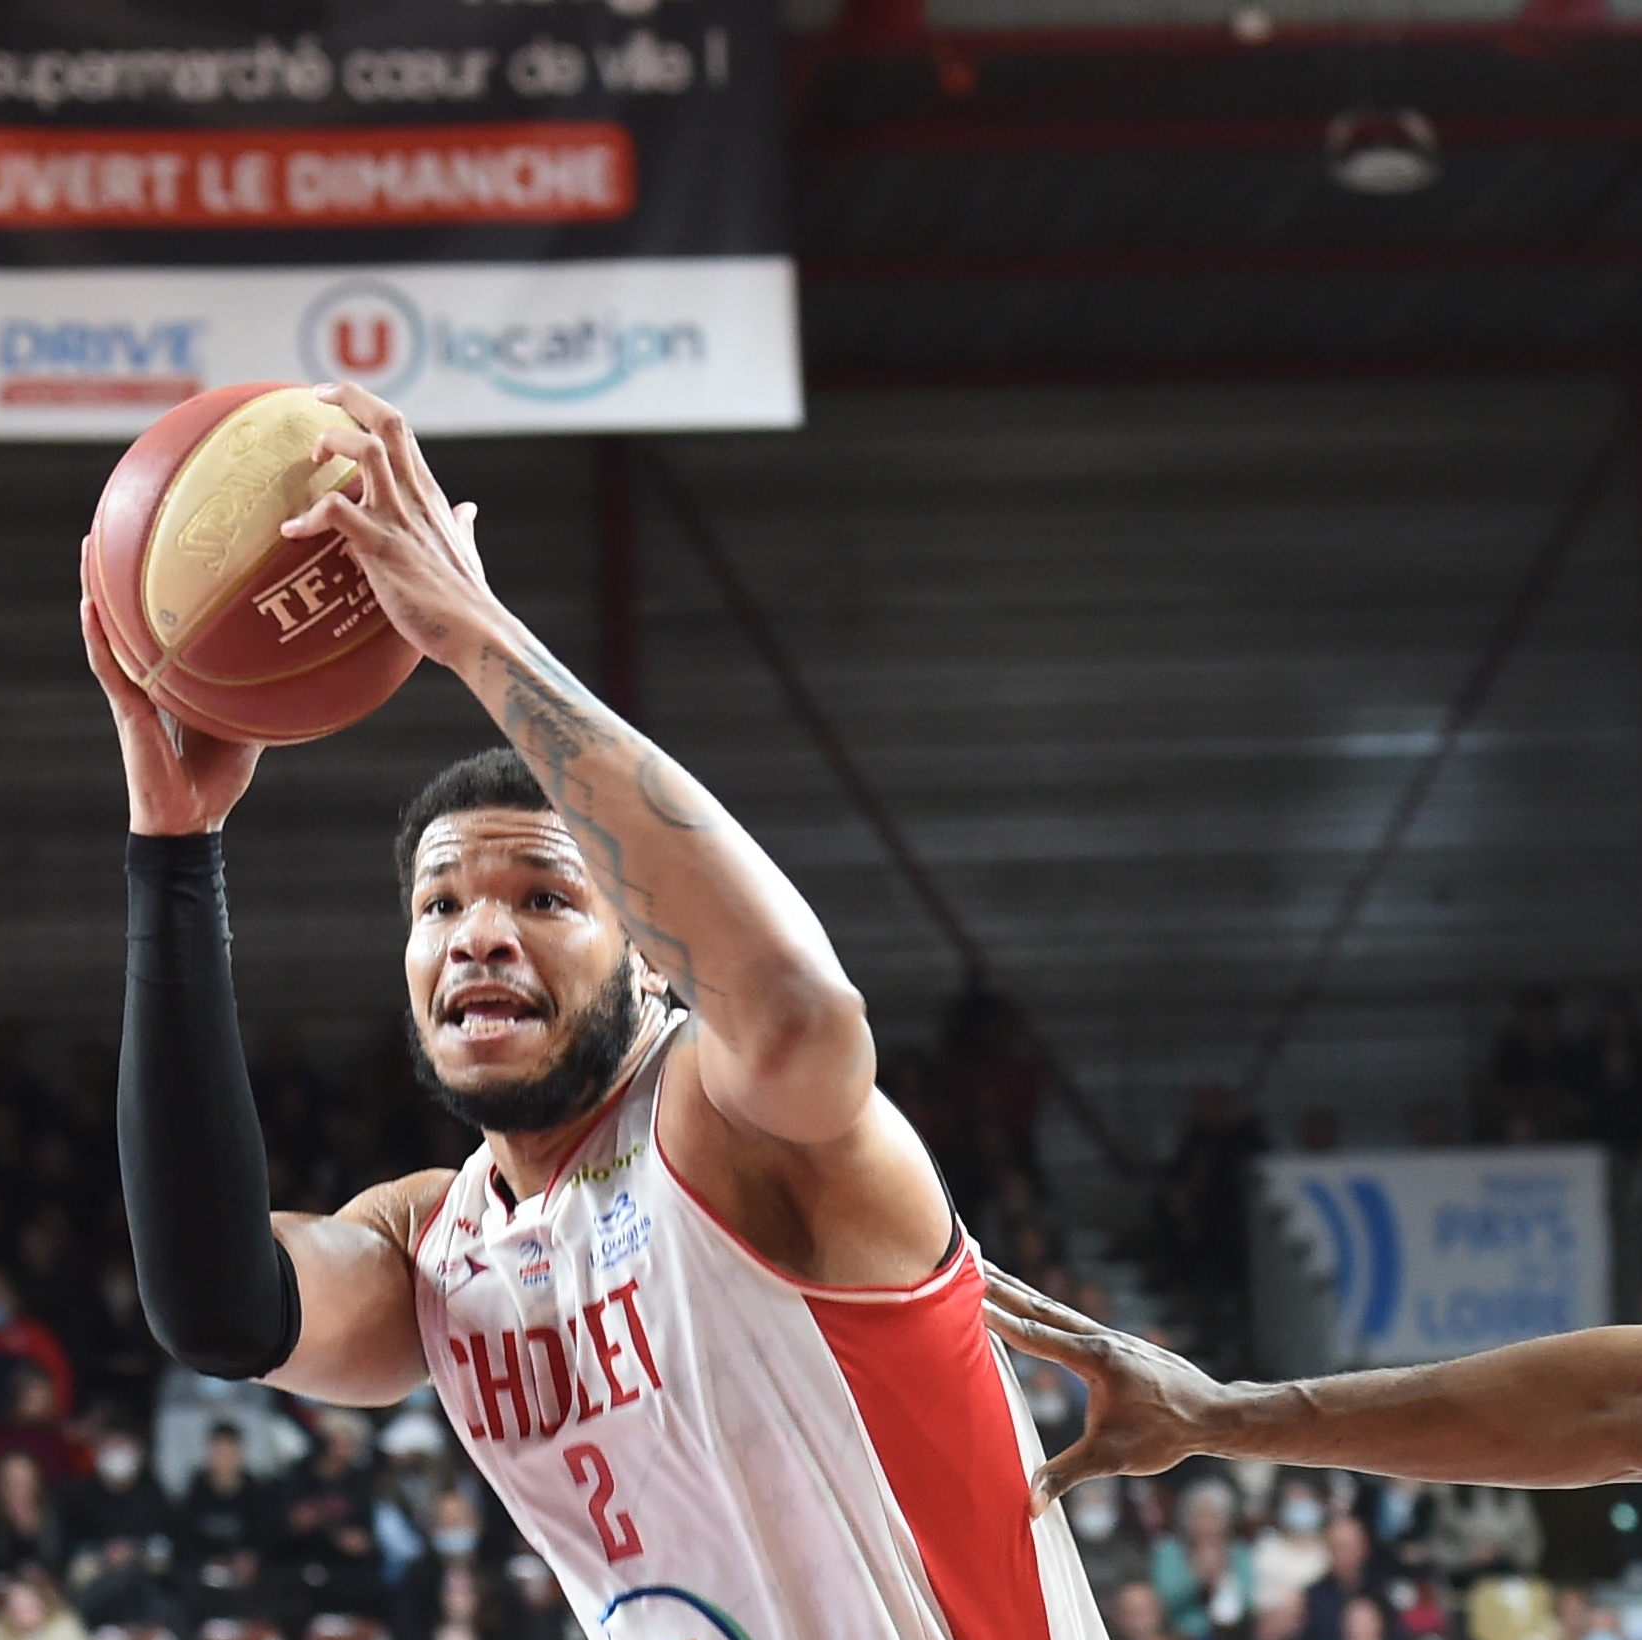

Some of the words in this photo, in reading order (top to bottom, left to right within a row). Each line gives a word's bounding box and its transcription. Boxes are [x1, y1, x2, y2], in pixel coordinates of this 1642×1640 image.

[198, 152, 269, 213] LE
[285, 143, 618, 212] DIMANCHE
[435, 308, 707, 370] location
[563, 1443, 643, 1565] 2
